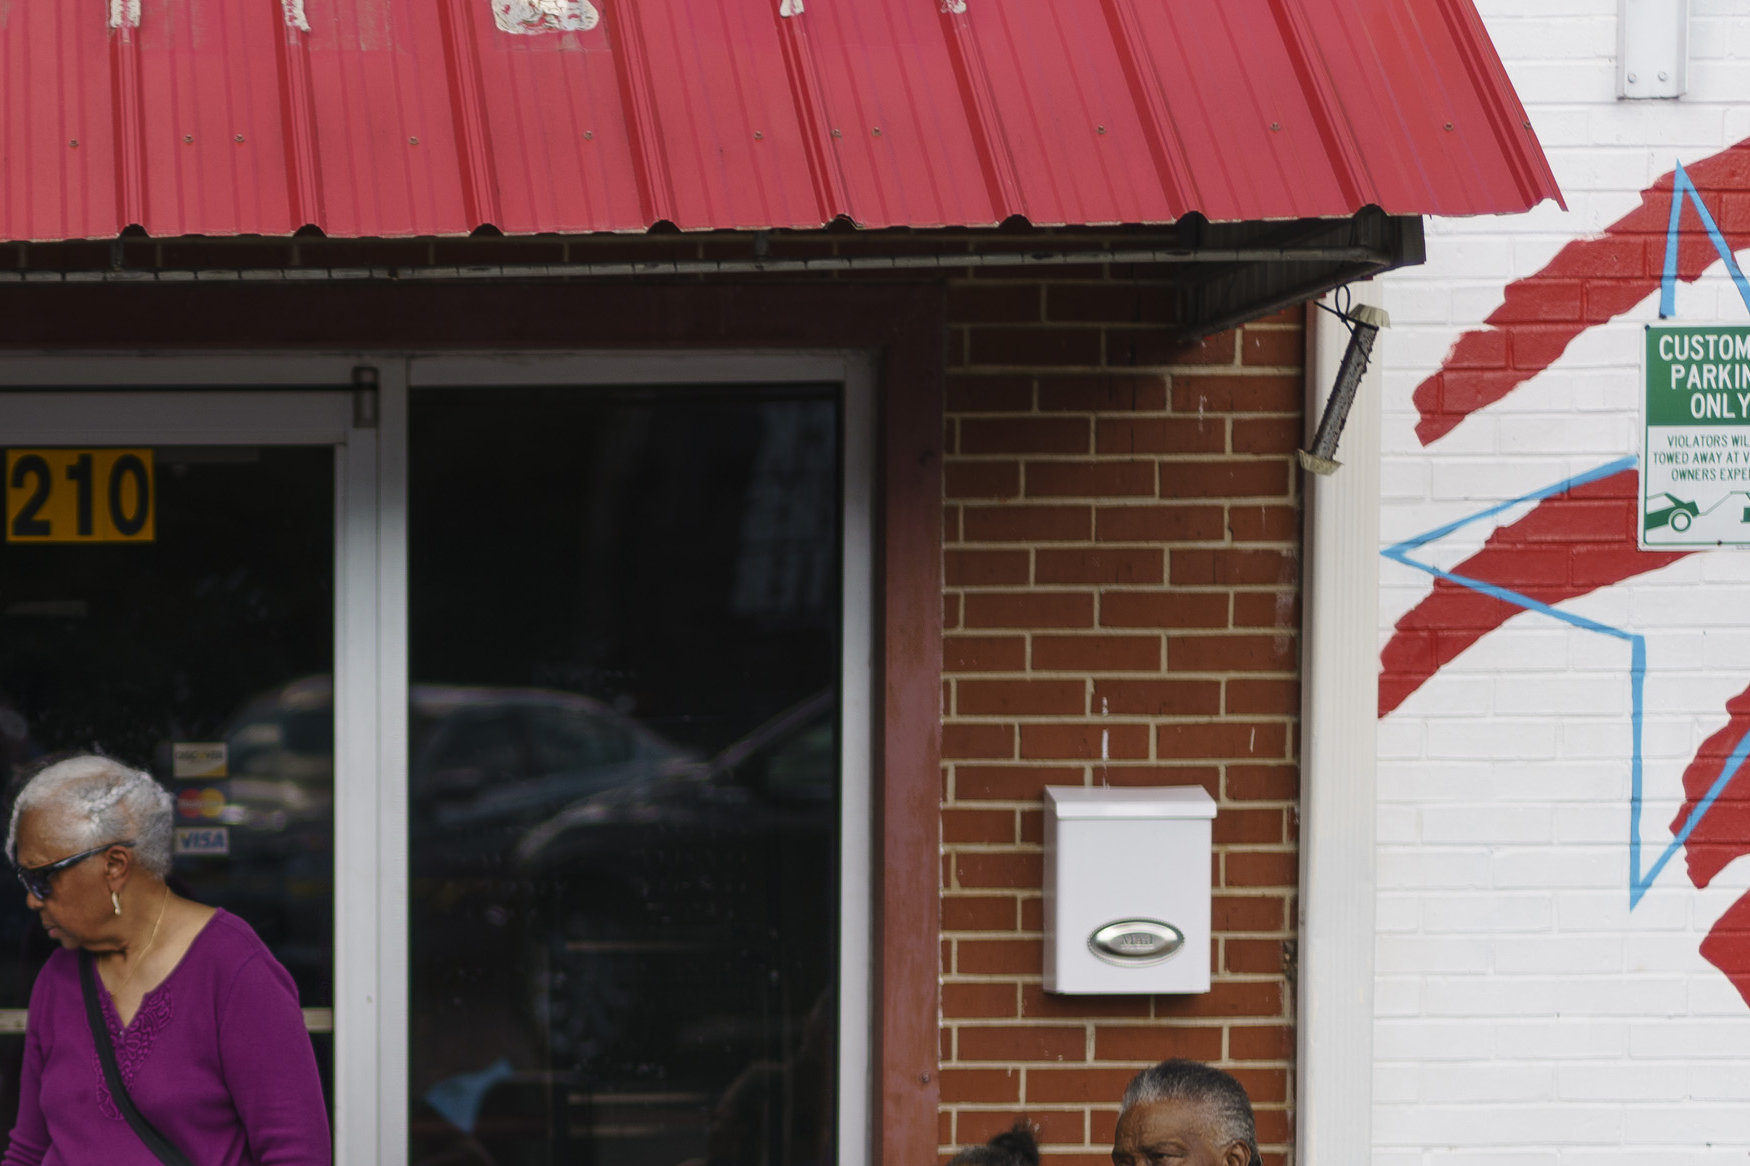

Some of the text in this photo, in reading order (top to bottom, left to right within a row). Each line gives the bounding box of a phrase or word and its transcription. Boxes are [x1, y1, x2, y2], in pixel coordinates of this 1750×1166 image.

[1659, 334, 1750, 361] CUSTOM
[1691, 392, 1750, 419] ONLY
[1667, 434, 1728, 448] VIOLATORS
[1652, 451, 1689, 465] TOWED
[1693, 451, 1722, 464] AWAY
[1726, 451, 1739, 464] AT
[1671, 467, 1750, 481] OWNERS EXPE
[10, 453, 150, 536] 210
[180, 831, 225, 849] VISA
[1121, 934, 1154, 946] Mail
